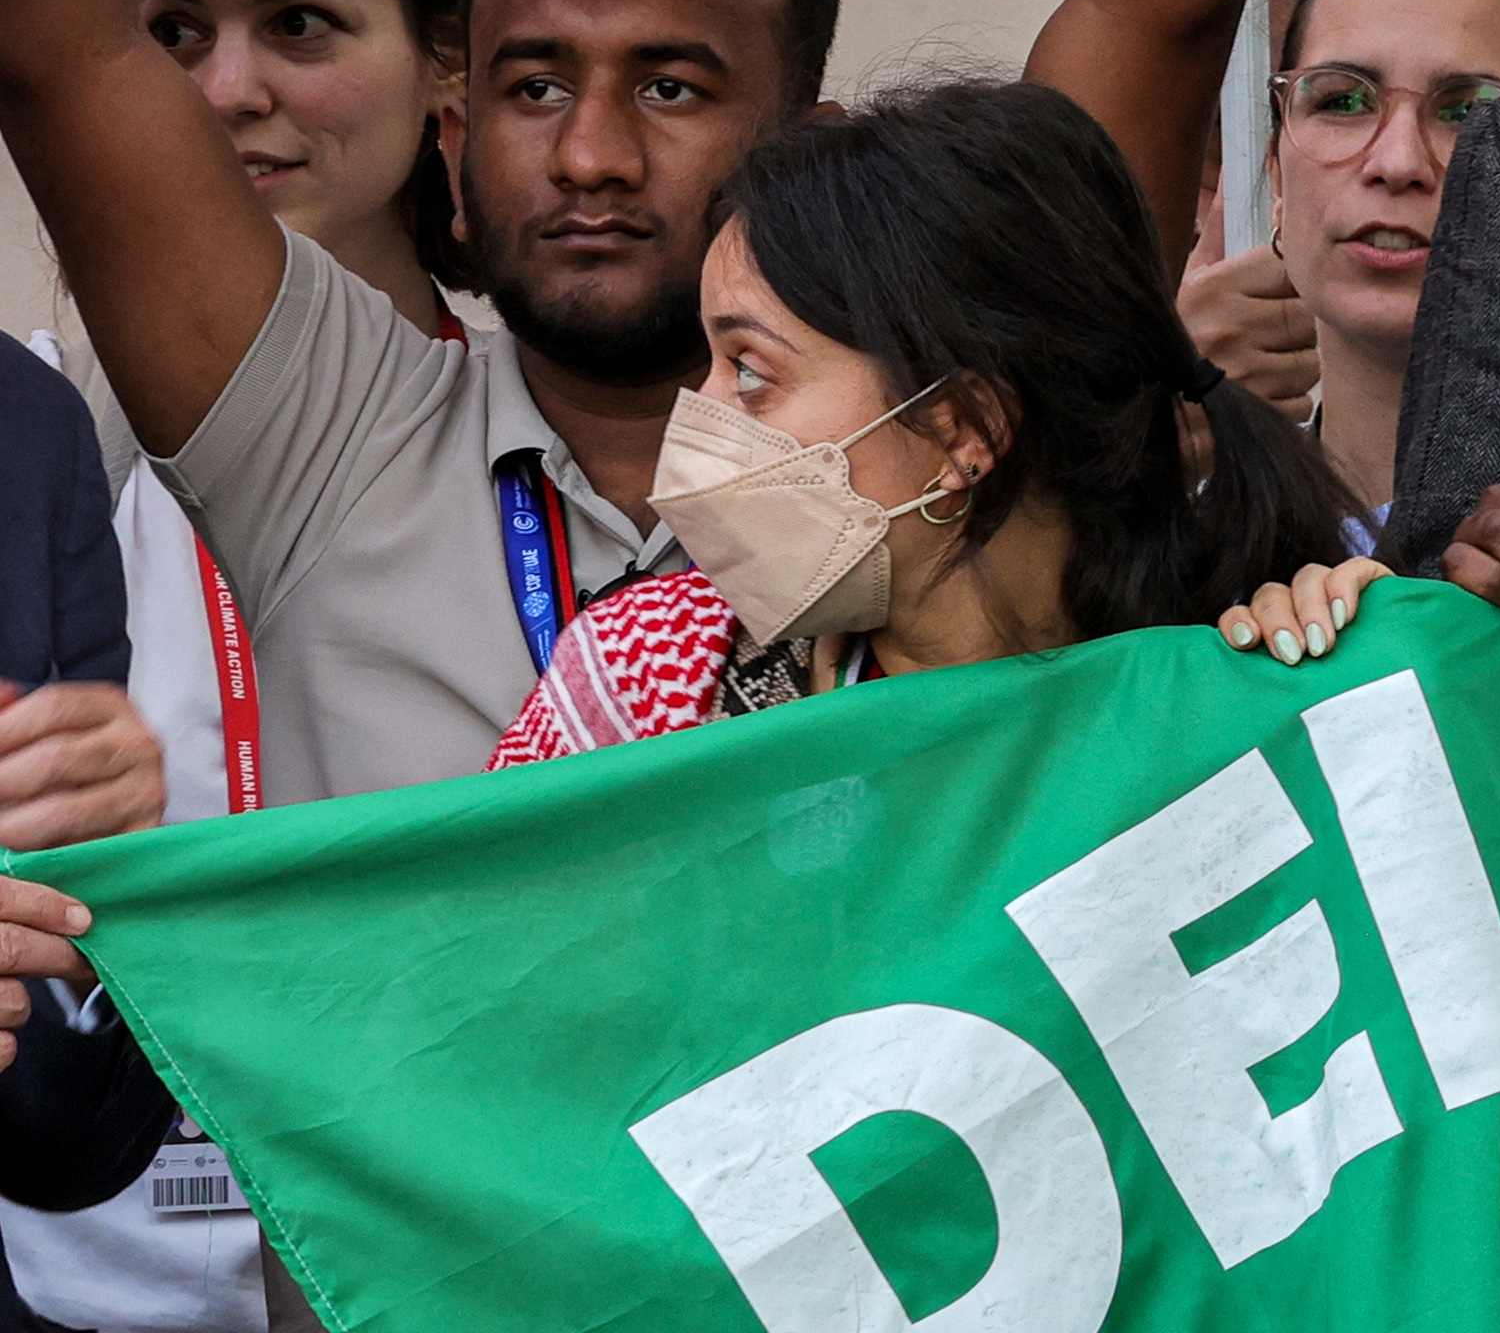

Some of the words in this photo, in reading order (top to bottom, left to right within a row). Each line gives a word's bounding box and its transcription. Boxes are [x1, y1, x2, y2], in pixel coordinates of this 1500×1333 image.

[217, 587, 240, 648] CLIMATE
[225, 648, 246, 701] ACTION
[237, 740, 256, 792] HUMAN
